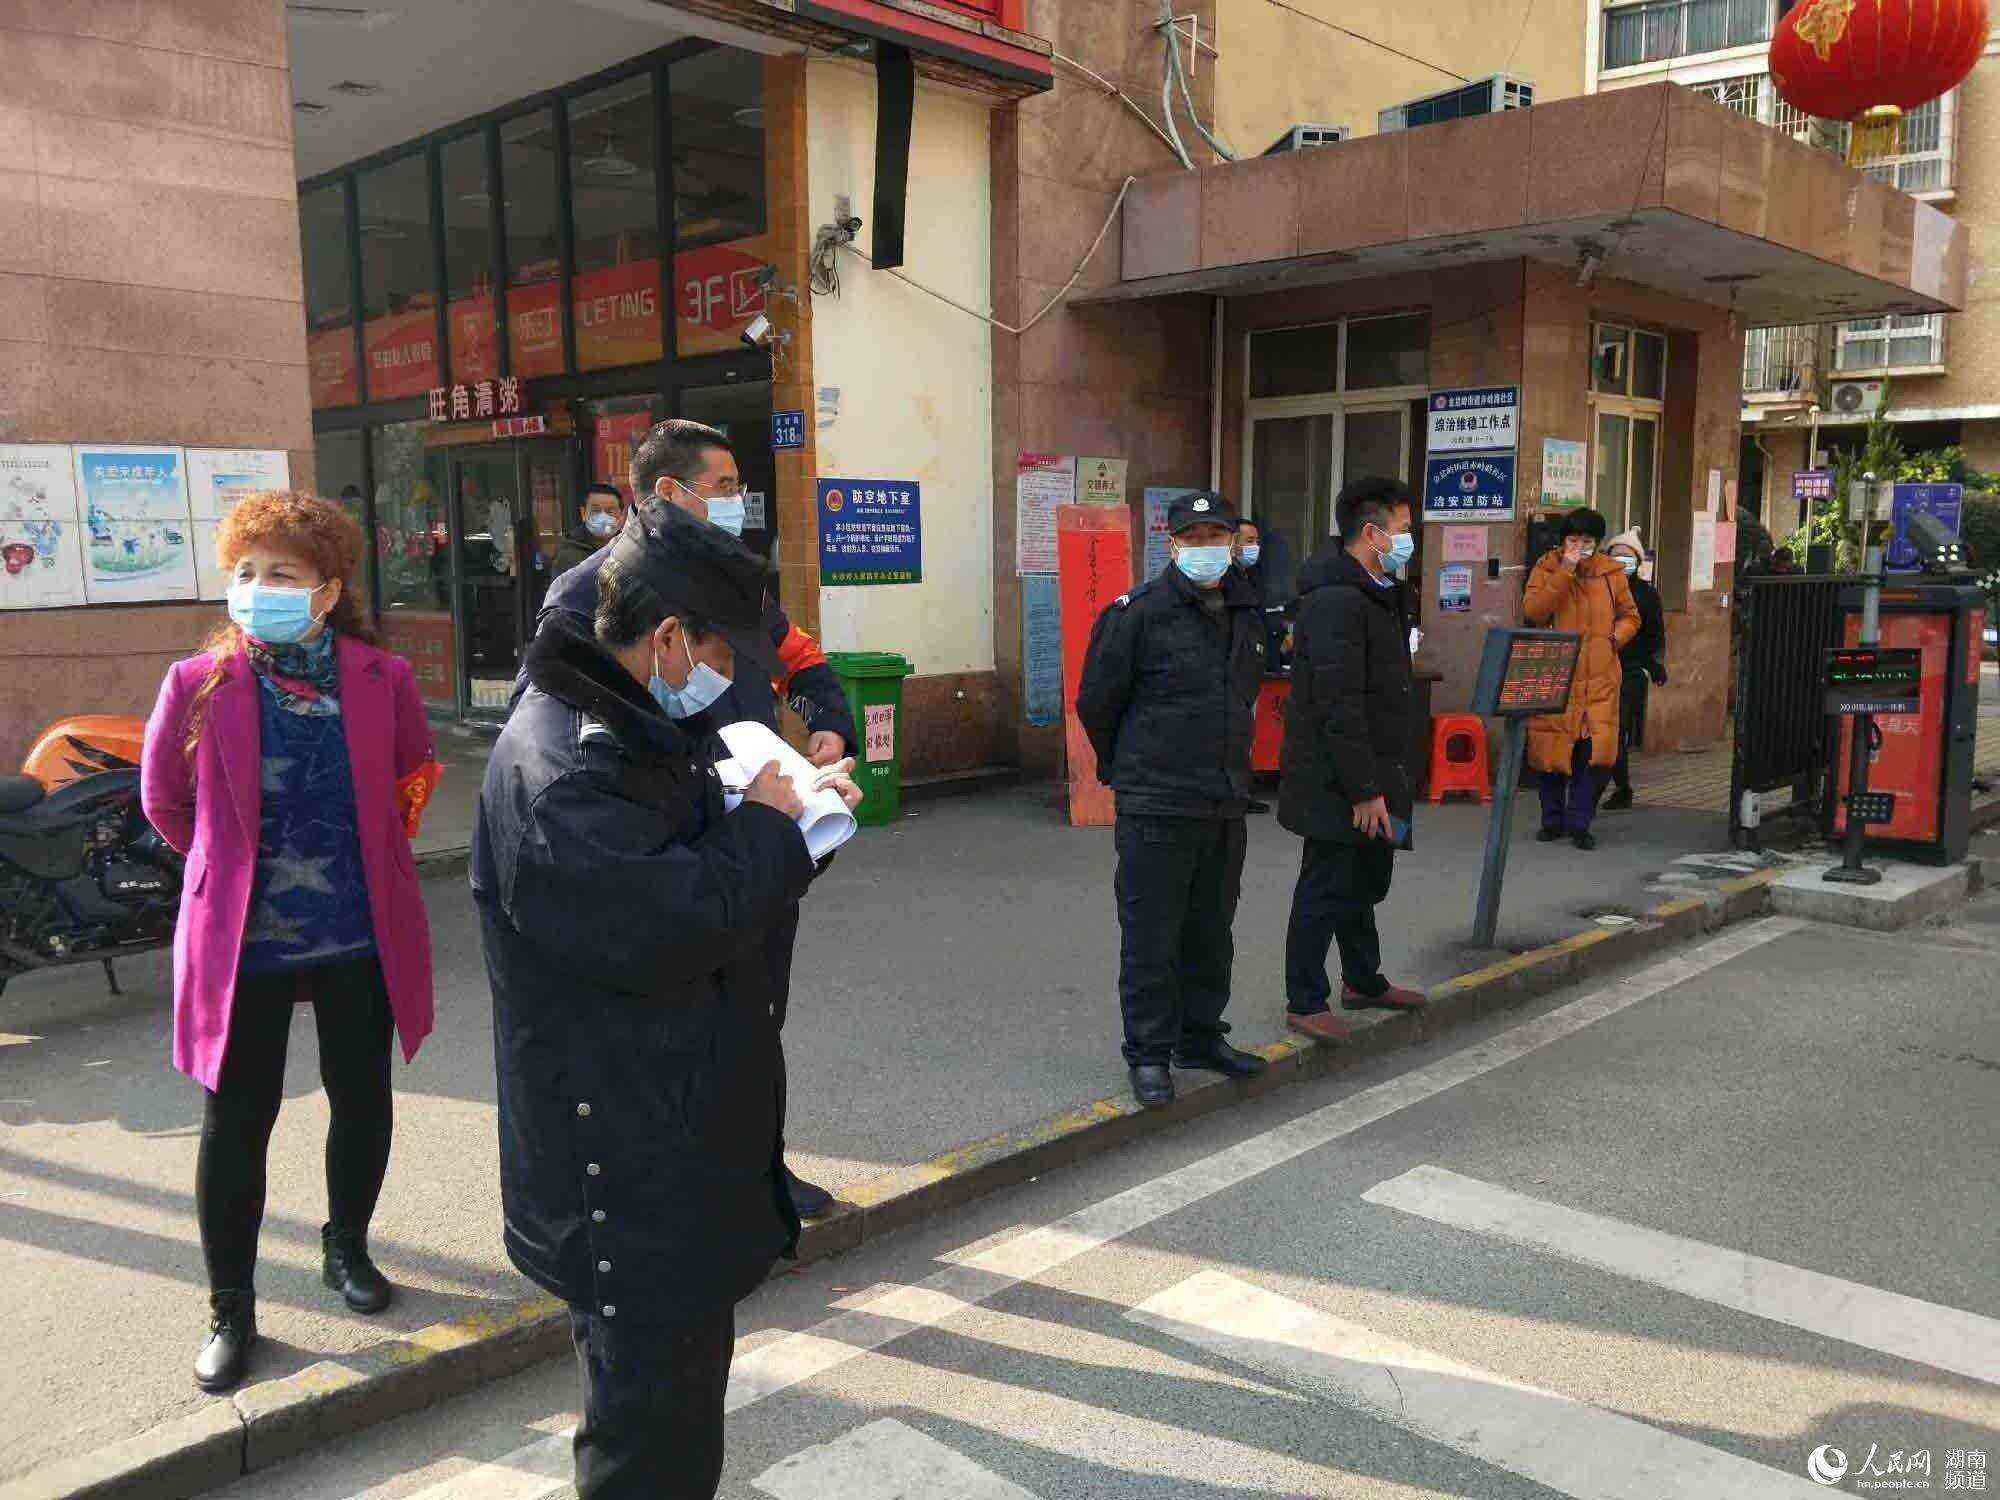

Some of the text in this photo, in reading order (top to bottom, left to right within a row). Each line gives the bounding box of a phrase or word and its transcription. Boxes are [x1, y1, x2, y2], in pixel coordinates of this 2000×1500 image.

[582, 286, 654, 327] LETING
[685, 275, 723, 324] 3F
[430, 376, 519, 421] 旺角清粥
[1434, 413, 1511, 432] 综治维稳工作点
[852, 489, 911, 505] 防空地下室
[1433, 495, 1504, 508] 治安巡防站
